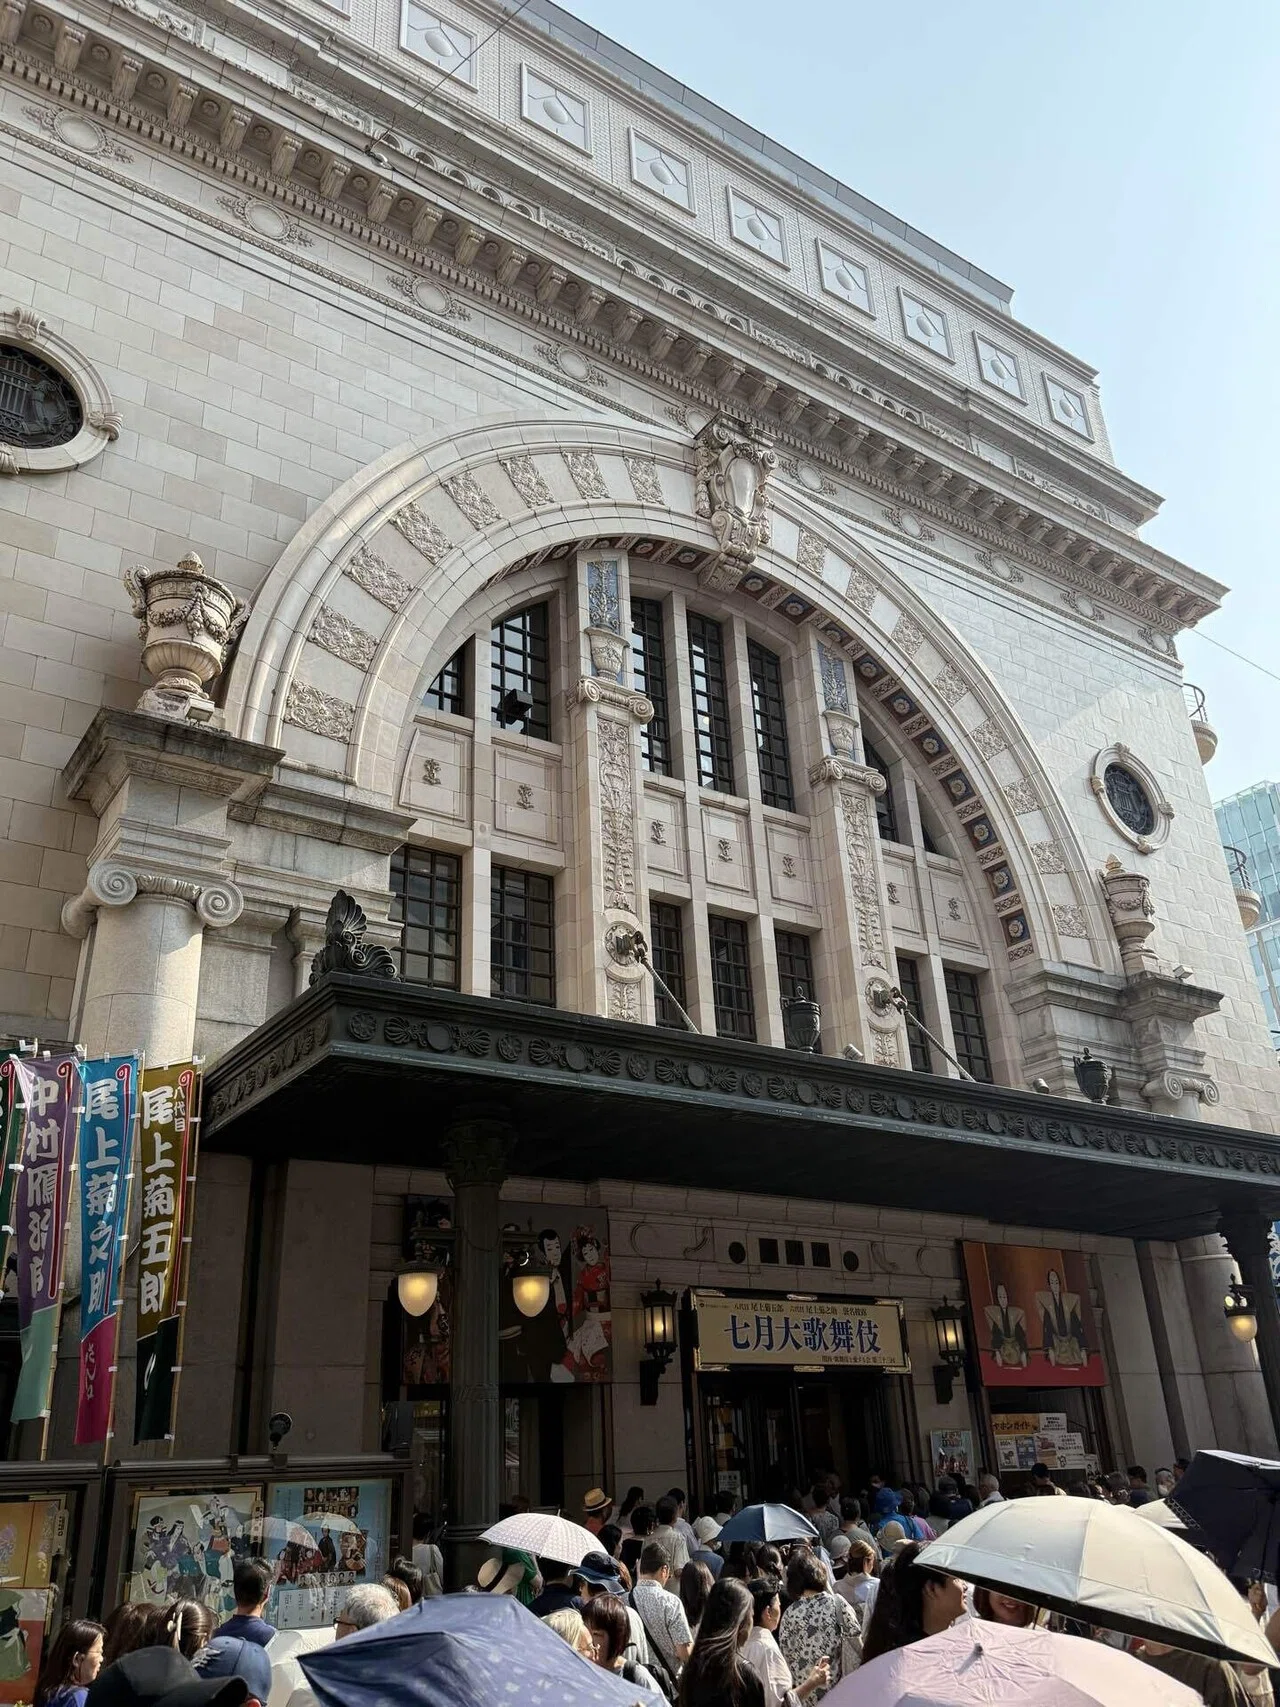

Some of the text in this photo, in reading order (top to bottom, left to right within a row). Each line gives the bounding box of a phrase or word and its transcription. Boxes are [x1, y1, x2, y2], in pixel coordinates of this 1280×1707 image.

[173, 1085, 187, 1133] 八代目
[139, 1088, 177, 1316] 尾上菊五郎
[724, 1314, 882, 1354] 七月大歌舞伎
